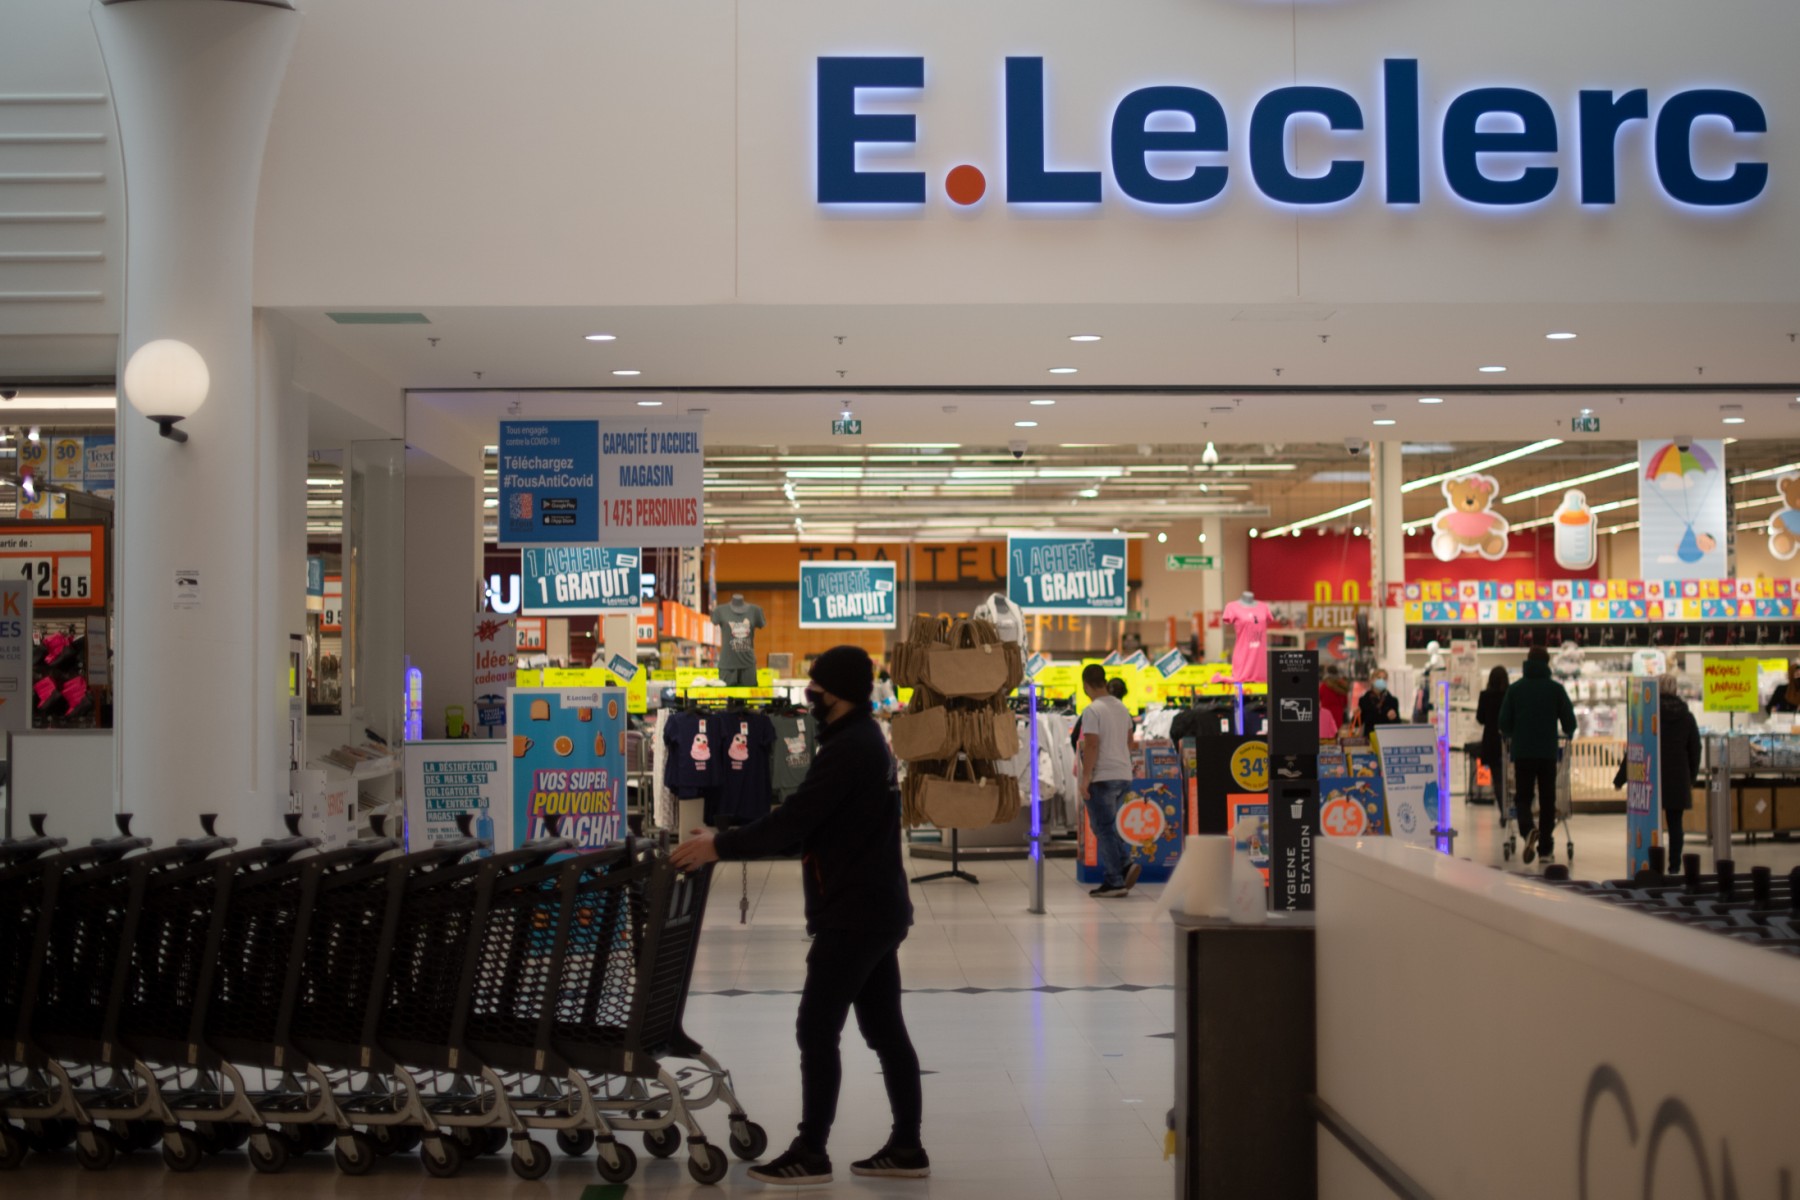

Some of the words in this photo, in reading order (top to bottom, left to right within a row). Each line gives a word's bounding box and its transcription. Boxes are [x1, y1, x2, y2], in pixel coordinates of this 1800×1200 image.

[816, 55, 1769, 207] E.Leclerc
[22, 445, 42, 460] 50
[56, 444, 76, 460] 30
[602, 427, 648, 455] CAPACITÉ
[650, 432, 700, 455] D'ACCUEIL
[87, 448, 115, 464] Text
[503, 456, 574, 473] Téléchargez
[503, 473, 594, 489] #TousAntiCovid
[619, 464, 674, 487] MAGASIN
[635, 497, 698, 528] PERSONNES
[0, 539, 17, 548] artir
[19, 539, 28, 548] de
[1013, 548, 1024, 577] 1
[1030, 539, 1096, 576] ACHETÉ
[537, 576, 549, 605] 1
[555, 567, 630, 603] GRATUIT
[1023, 575, 1035, 604] 1
[1040, 568, 1116, 603] GRATUIT
[812, 597, 821, 620] 1
[826, 590, 887, 619] GRATUIT
[424, 762, 435, 772] LA
[425, 775, 440, 784] DES
[471, 774, 487, 783] EST
[538, 771, 567, 791] VOS
[569, 771, 608, 791] SUPER
[426, 786, 478, 797] OBLIGATOIRE
[532, 791, 612, 815] POUVOIRS
[1300, 824, 1311, 894] STATION
